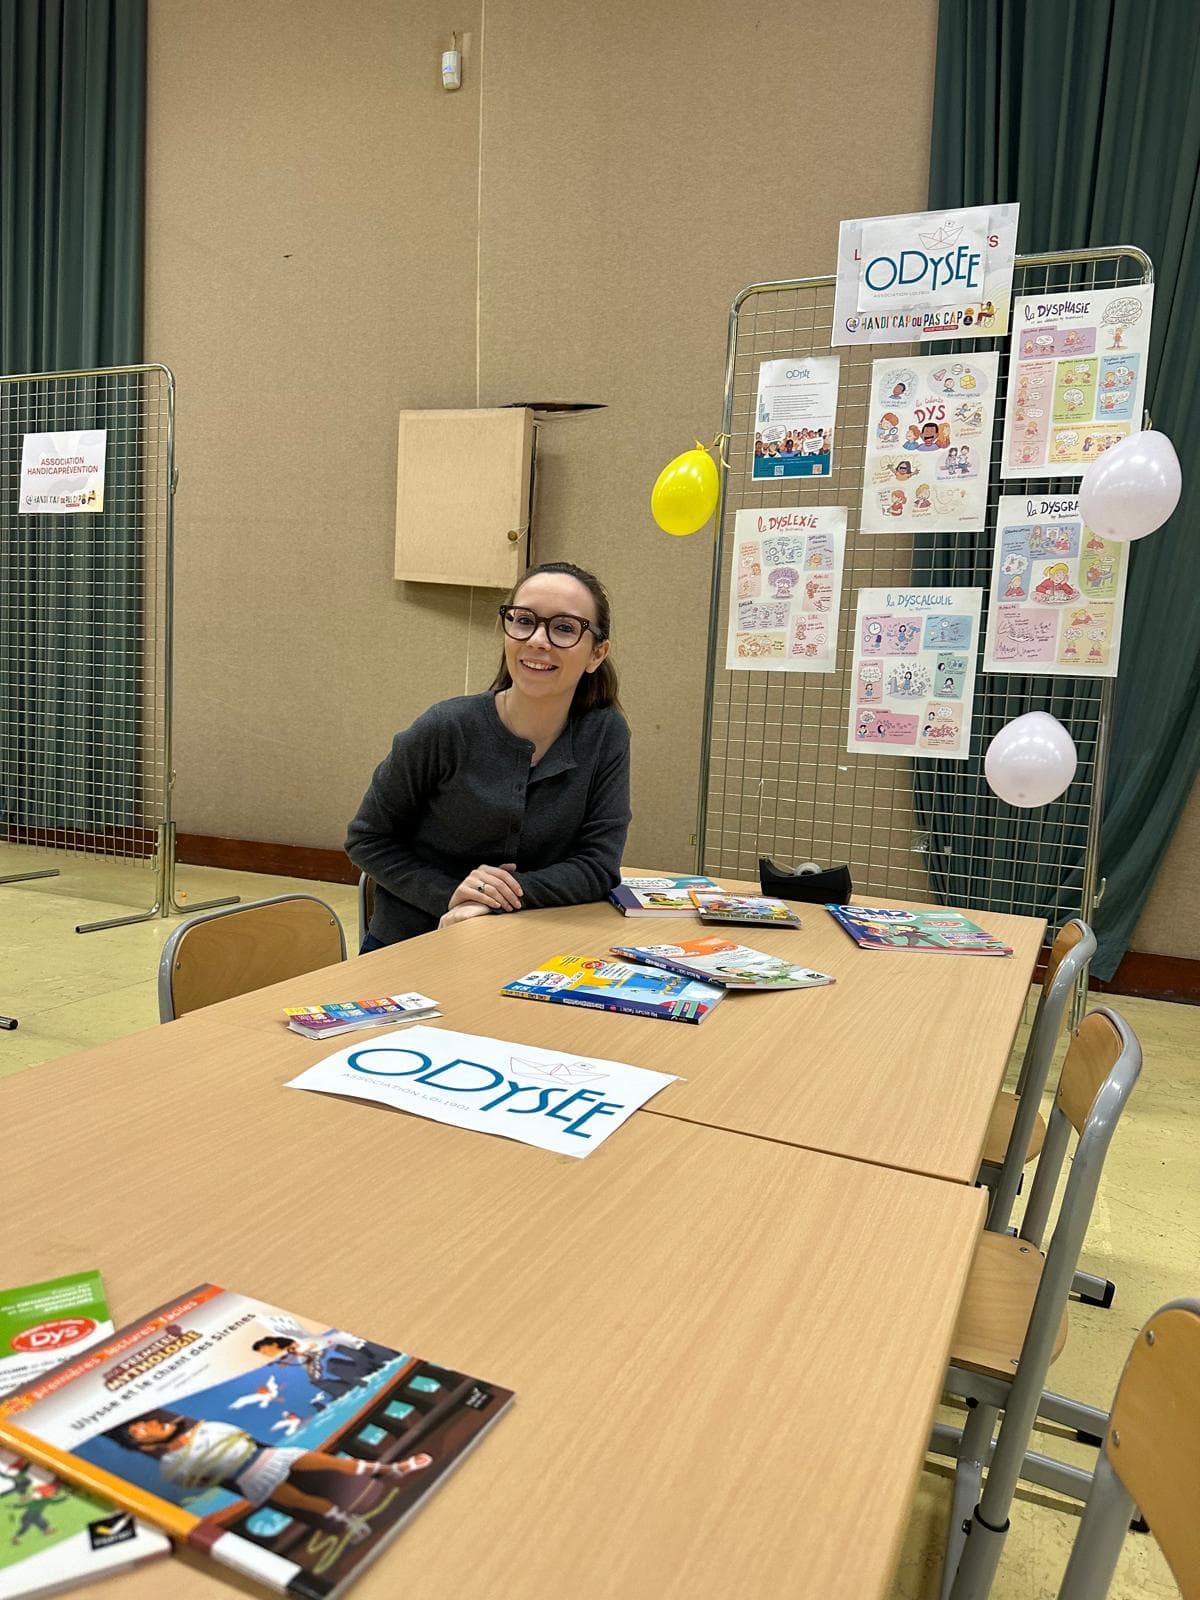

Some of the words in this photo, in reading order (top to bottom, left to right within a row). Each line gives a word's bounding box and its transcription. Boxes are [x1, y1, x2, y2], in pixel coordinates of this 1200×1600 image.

[865, 246, 981, 291] ODYSEE
[924, 311, 941, 327] PAS
[944, 310, 963, 325] CAP
[914, 404, 946, 424] DYS
[40, 456, 85, 466] ASSOCIATION
[1027, 500, 1037, 517] la
[1040, 500, 1080, 514] DYSGRA
[897, 594, 954, 608] DYSCALCULIE
[341, 1073, 420, 1096] ASSOCIATION
[422, 1094, 442, 1103] LOI
[444, 1100, 470, 1111] 1901
[347, 1048, 625, 1139] ODYSEE
[31, 1325, 80, 1347] Dys
[107, 1330, 201, 1391] MYTHOLOGIE
[71, 1401, 120, 1430] Ulysse
[121, 1388, 137, 1399] et
[134, 1380, 151, 1390] le
[152, 1355, 191, 1380] chant
[190, 1341, 214, 1356] des
